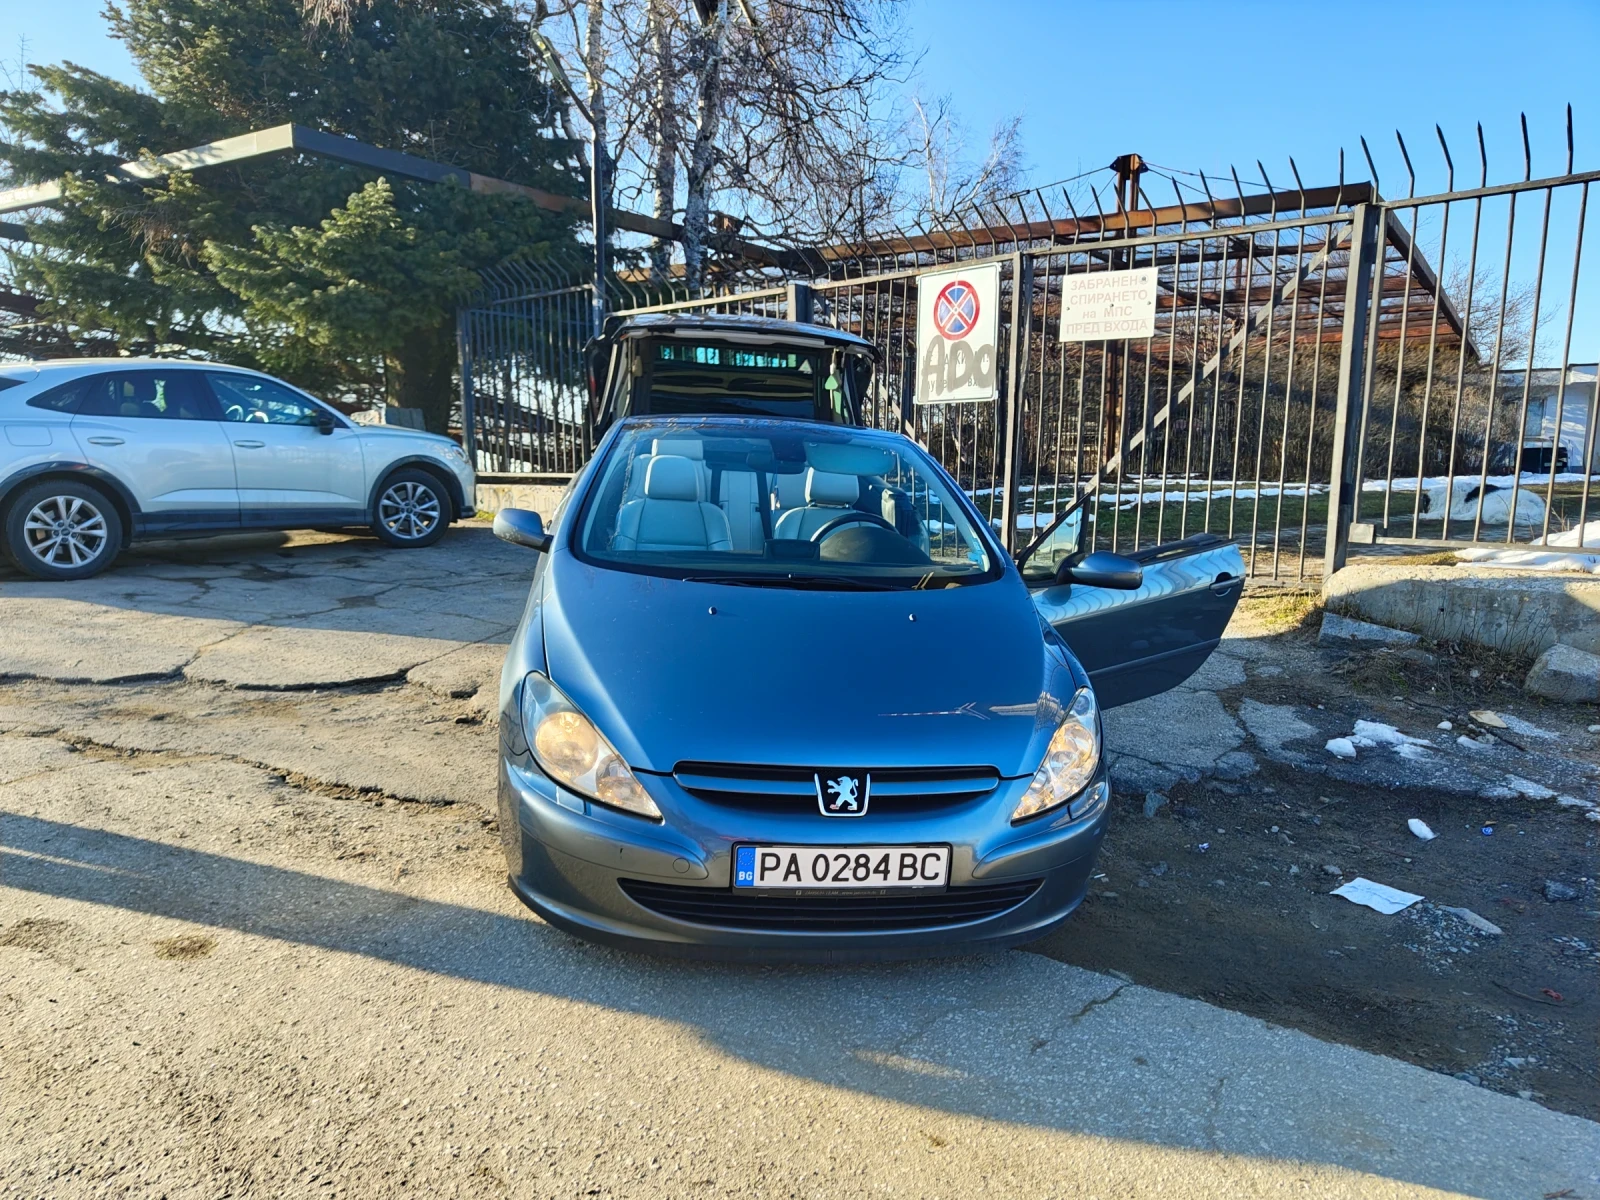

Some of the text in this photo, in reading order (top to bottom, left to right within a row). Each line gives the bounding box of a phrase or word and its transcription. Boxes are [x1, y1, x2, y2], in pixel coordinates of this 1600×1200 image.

[1070, 289, 1148, 305] СПИРАНЕТО
[1082, 305, 1132, 319] на МПС
[1066, 319, 1148, 335] ПРЕД ВХОДА
[759, 852, 941, 882] PA 0284 BC
[738, 871, 753, 881] BG
